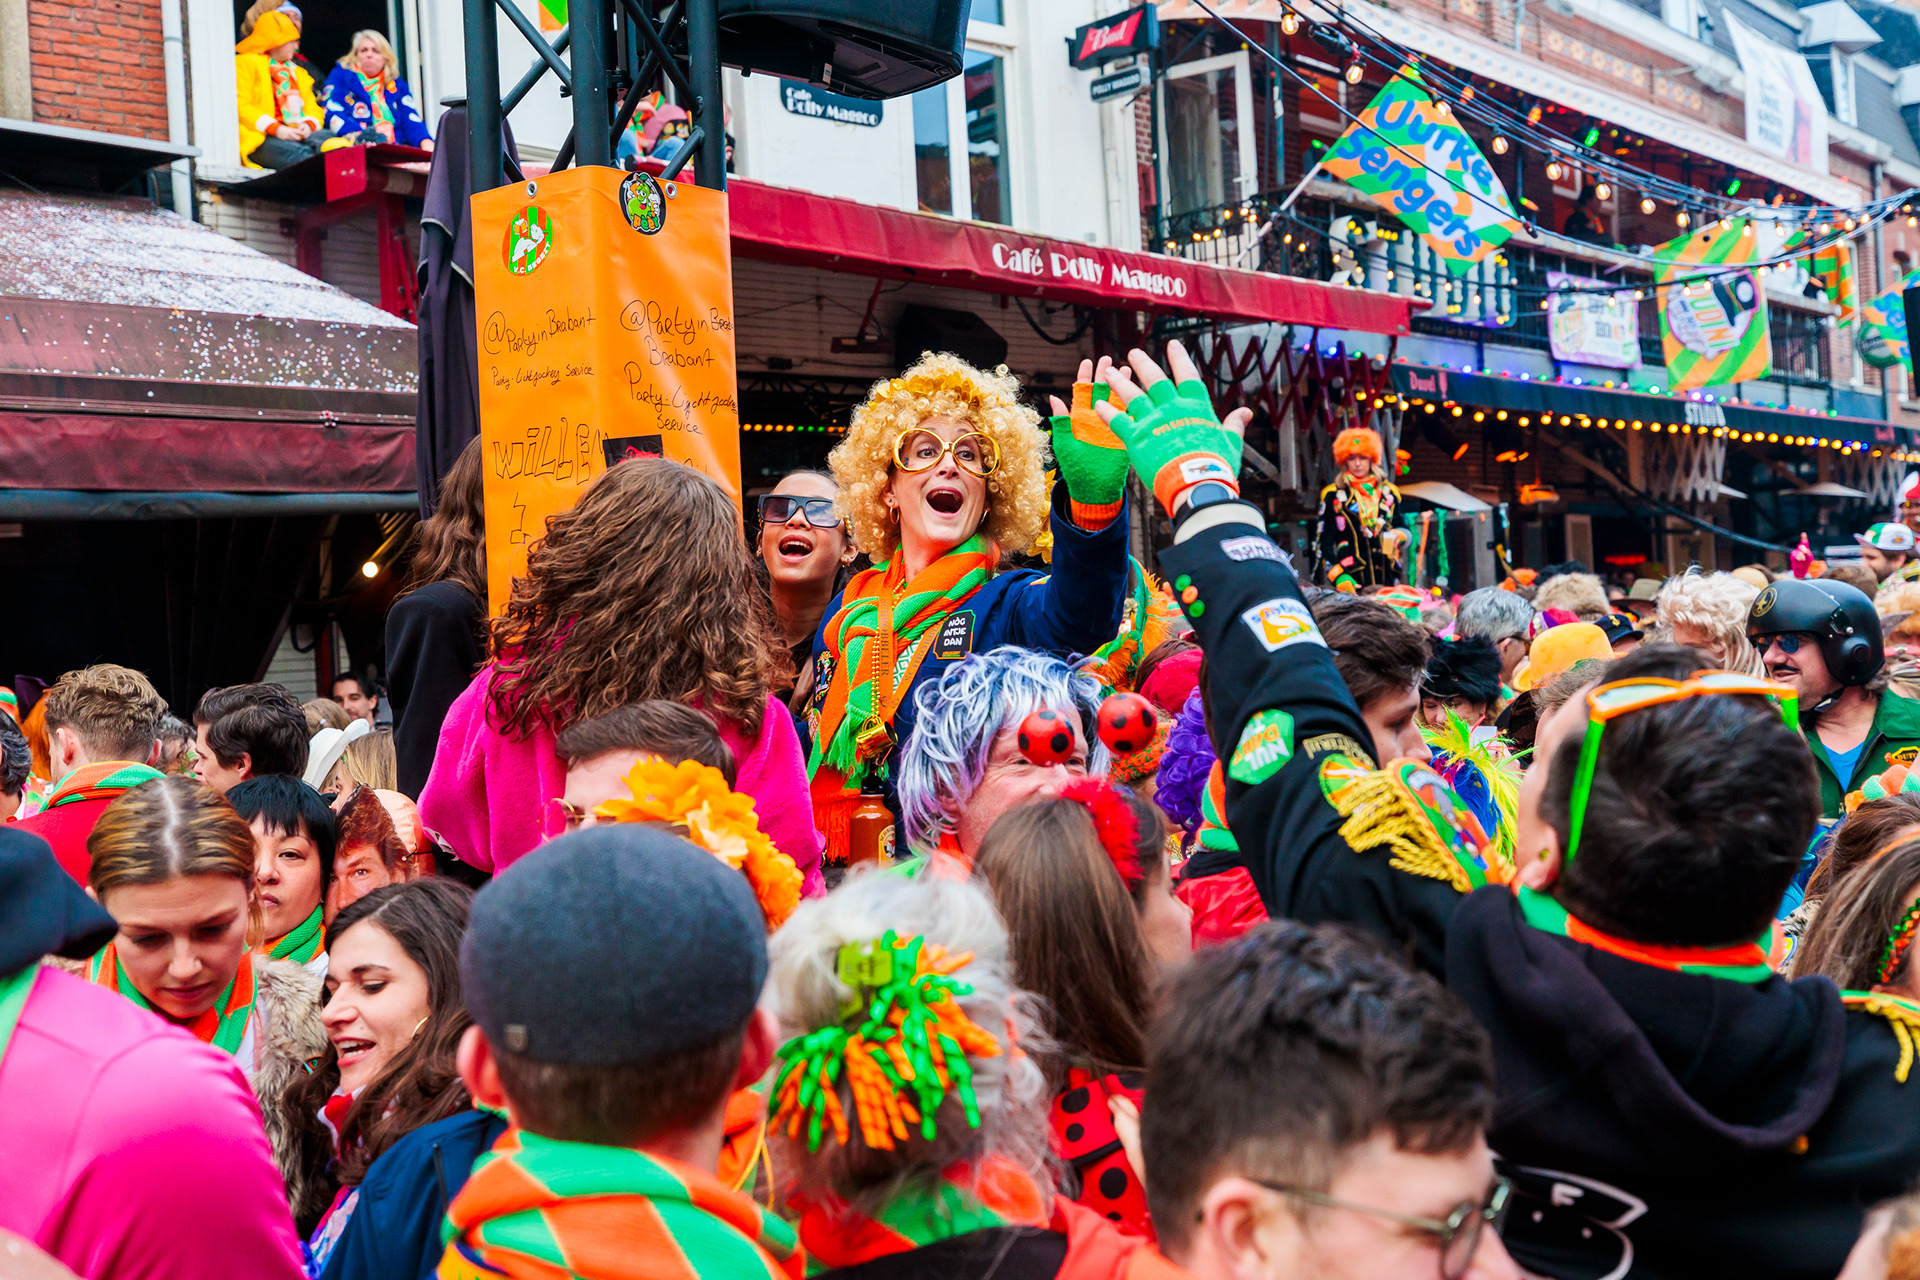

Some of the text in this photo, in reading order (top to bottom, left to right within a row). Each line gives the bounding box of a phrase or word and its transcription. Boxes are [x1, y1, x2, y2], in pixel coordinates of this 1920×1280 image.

[1091, 20, 1128, 51] Bud
[1375, 92, 1494, 188] Uurke
[1336, 127, 1482, 257] Sengers
[992, 242, 1187, 298] Café Polly Maggoo
[656, 413, 703, 435] Service
[880, 599, 890, 676] SCHROBBELER
[943, 637, 963, 647] DAN
[1244, 737, 1291, 771] NUL
